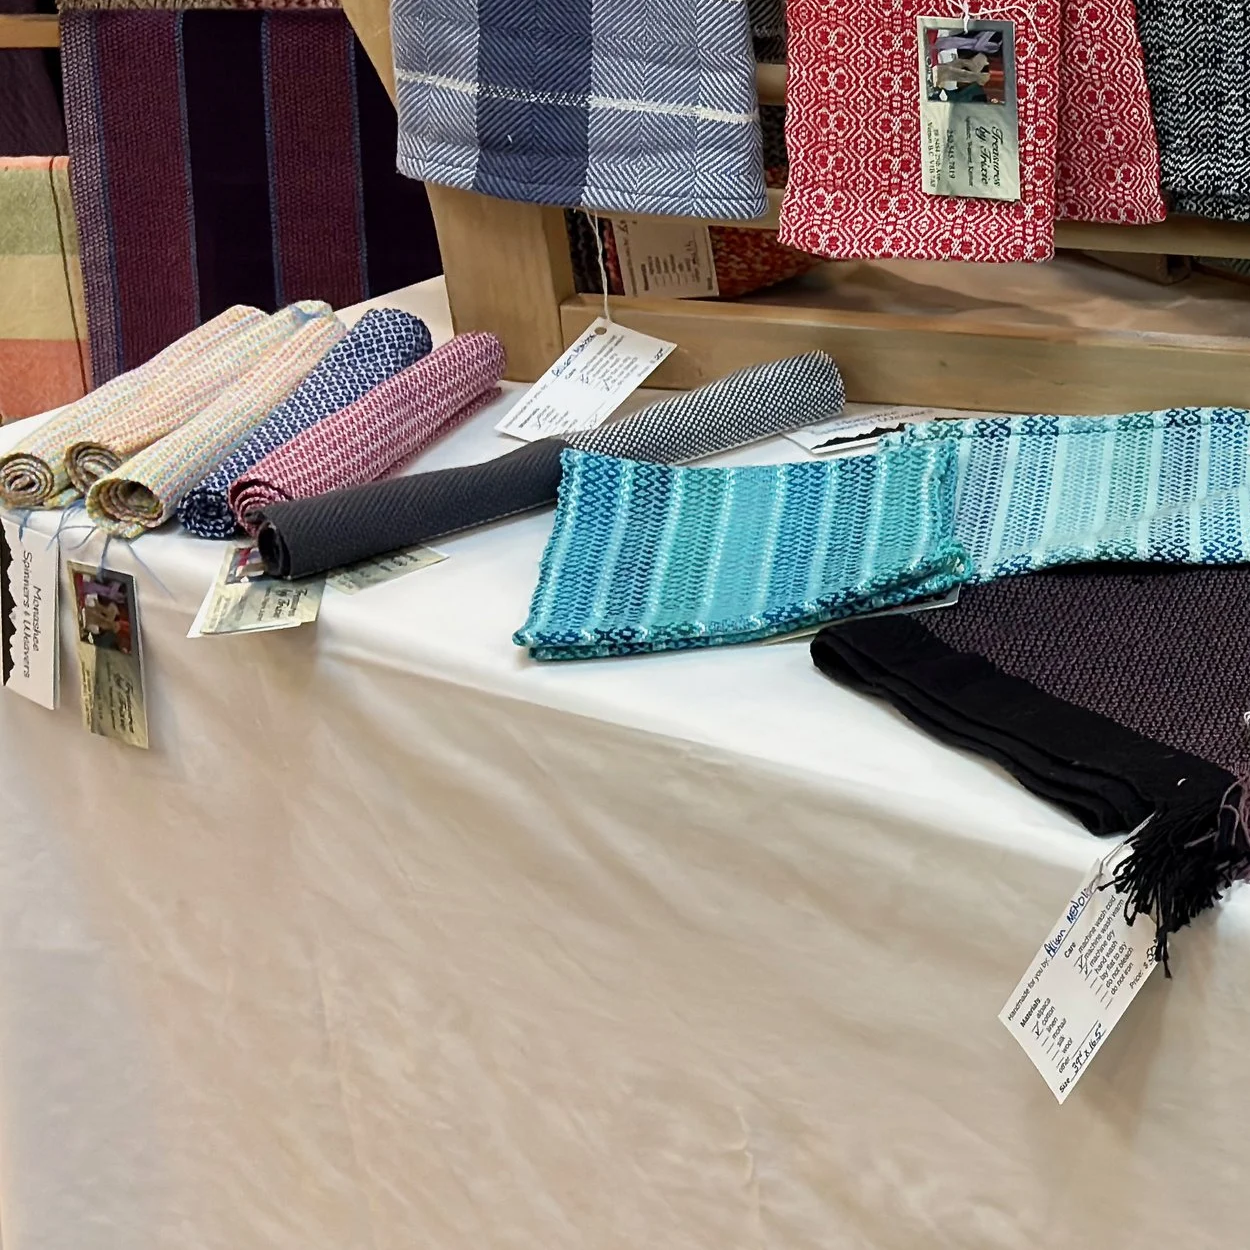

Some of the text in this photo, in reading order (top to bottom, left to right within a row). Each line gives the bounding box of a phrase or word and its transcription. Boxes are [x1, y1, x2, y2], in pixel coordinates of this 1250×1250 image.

[974, 126, 991, 142] by
[991, 125, 1004, 187] Treasures
[22, 550, 33, 608] Spinners
[32, 585, 42, 652] Monashee
[22, 619, 31, 678] Weavers
[1078, 894, 1117, 954] machine wash cold
[1081, 898, 1125, 961] machine wash warm
[1063, 941, 1077, 959] Care
[1089, 929, 1116, 968] machine dry
[1094, 940, 1118, 975] hand wash
[1099, 941, 1128, 981] lay flat to dry
[1105, 946, 1134, 989] do not bleach
[1007, 988, 1030, 1021] Handmade
[1027, 978, 1036, 990] for
[1033, 966, 1044, 982] you
[1110, 962, 1134, 996] do not iron
[1036, 997, 1051, 1019] alpaca
[1041, 1005, 1056, 1026] cotton
[1045, 1016, 1059, 1033] linen
[1061, 1037, 1073, 1054] wool
[1059, 1077, 1073, 1093] Size
